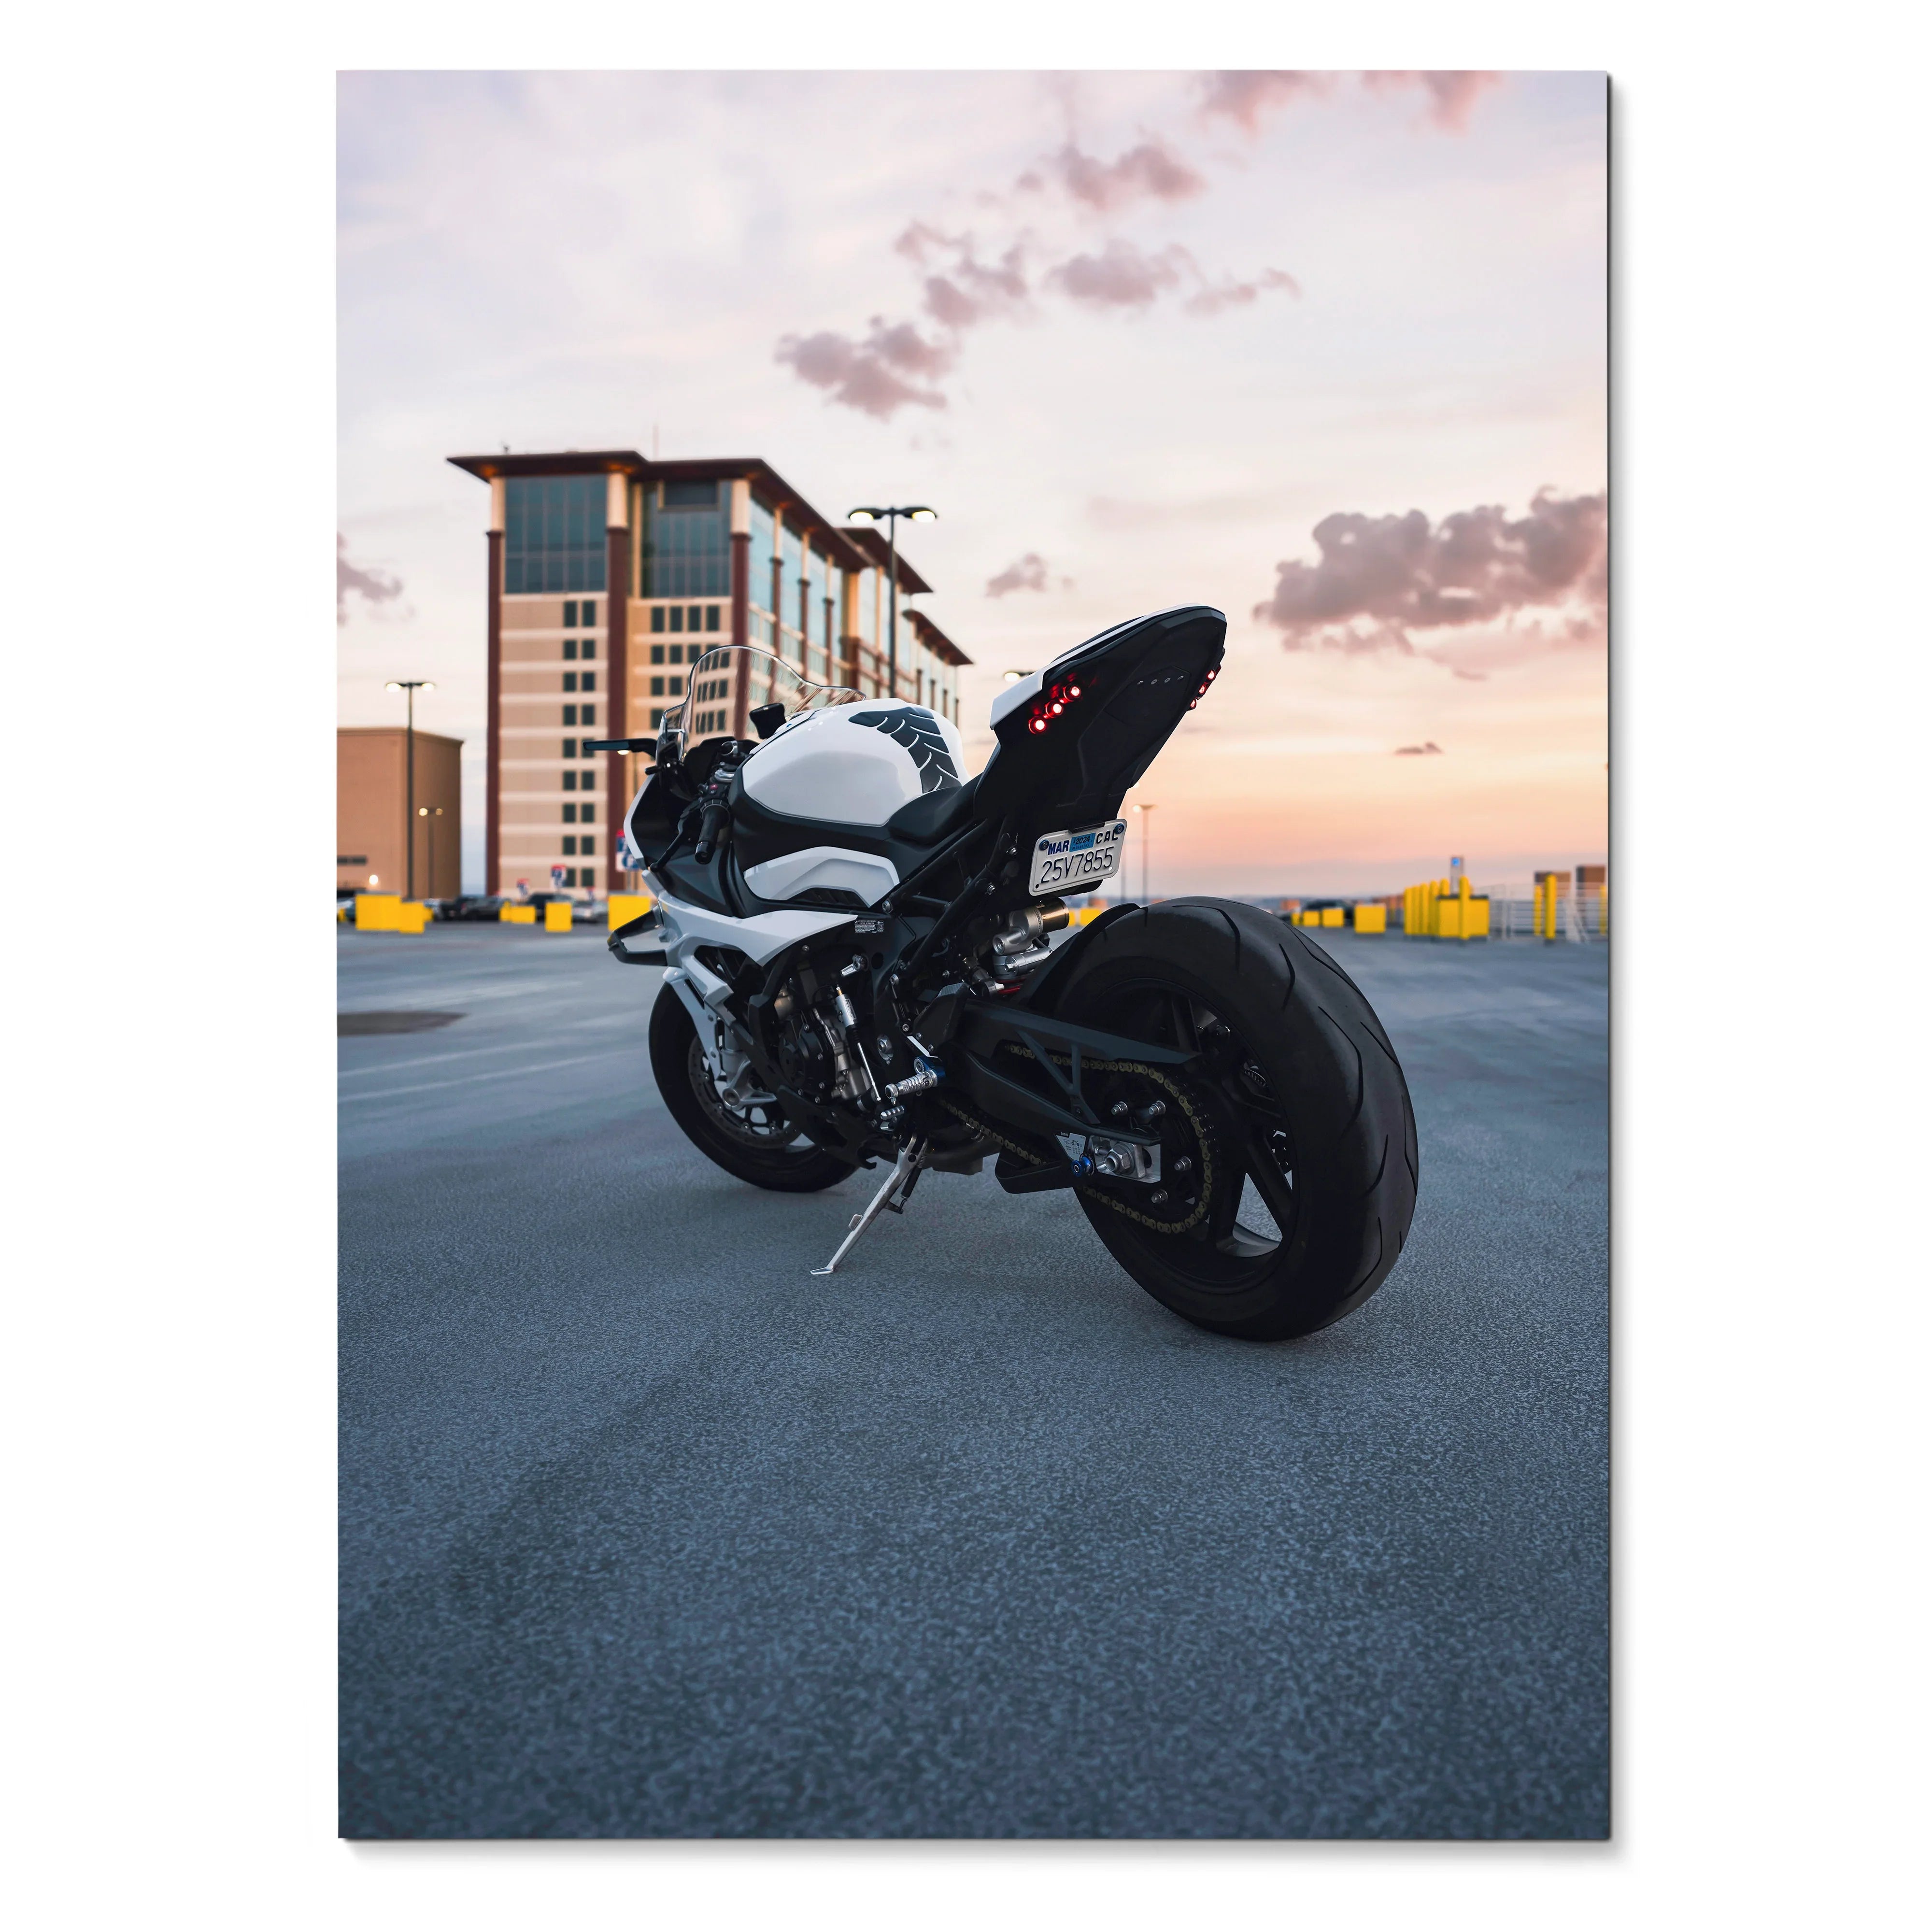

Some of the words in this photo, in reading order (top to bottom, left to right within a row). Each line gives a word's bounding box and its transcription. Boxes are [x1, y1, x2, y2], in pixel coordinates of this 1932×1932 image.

[1075, 836, 1090, 845] 2024
[1096, 829, 1118, 844] CAL
[1047, 840, 1070, 855] MAR
[1040, 846, 1114, 883] 25V7855
